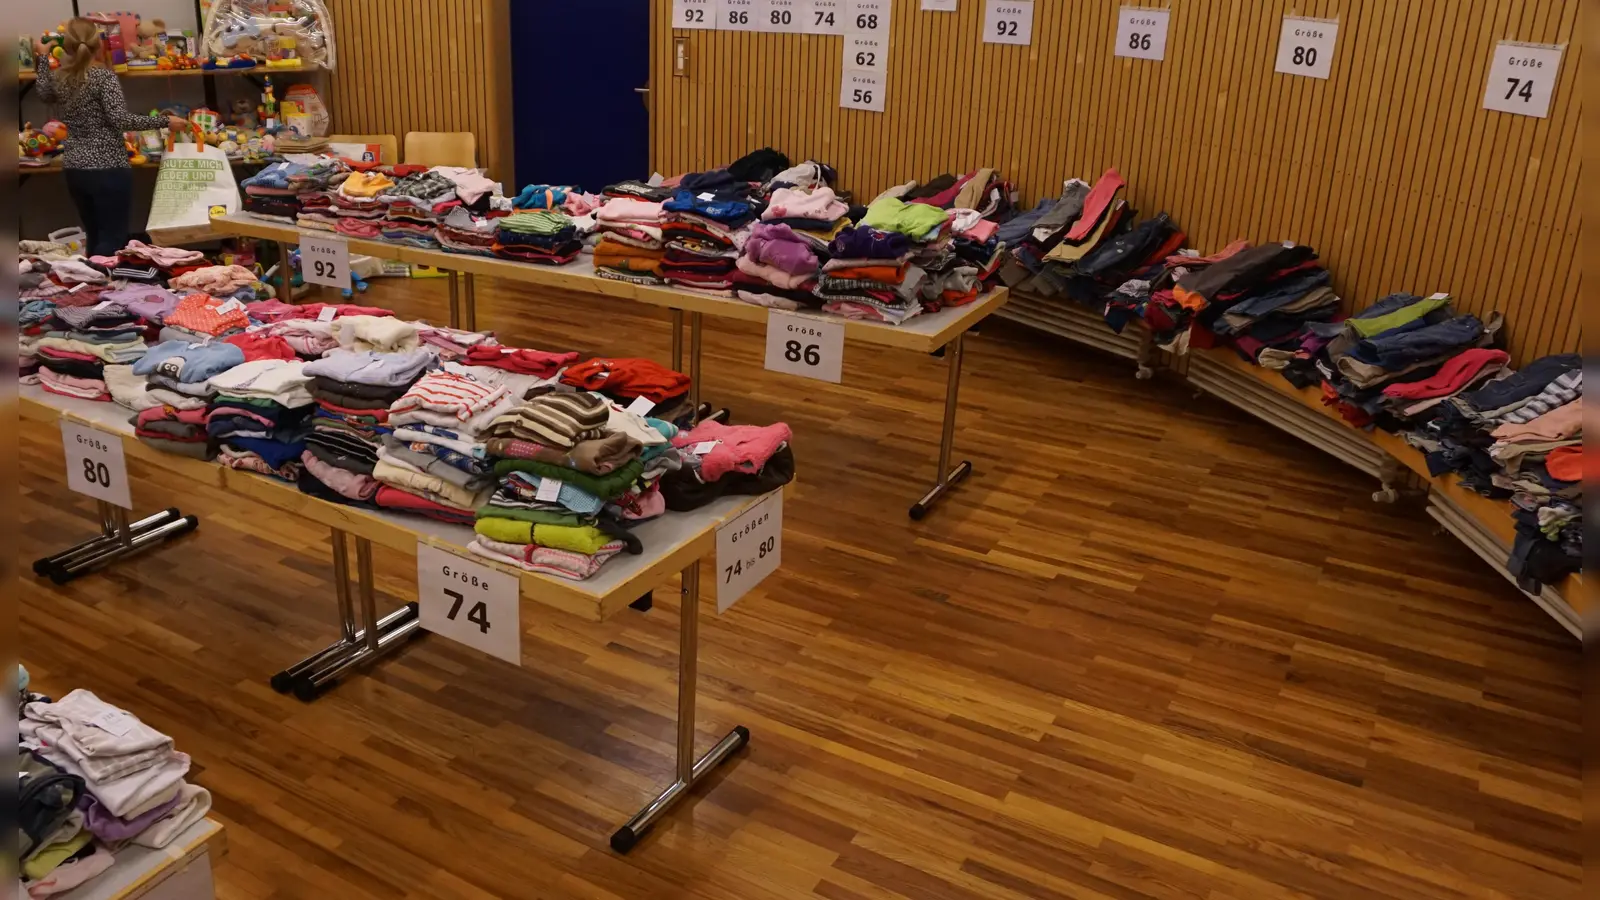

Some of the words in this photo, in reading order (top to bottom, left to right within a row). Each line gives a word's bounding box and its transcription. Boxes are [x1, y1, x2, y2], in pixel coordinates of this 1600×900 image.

[685, 9, 704, 22] 92
[728, 11, 749, 24] 86
[770, 10, 791, 24] 80
[814, 12, 835, 26] 74
[856, 14, 878, 29] 68
[1130, 17, 1156, 26] Größe
[997, 21, 1018, 36] 92
[1295, 29, 1323, 38] Größe
[1129, 33, 1151, 50] 86
[855, 52, 875, 66] 62
[1292, 46, 1317, 67] 80
[1508, 57, 1543, 68] Größe
[852, 89, 872, 104] 56
[1504, 78, 1534, 102] 74
[161, 160, 195, 169] NUTZE
[197, 160, 223, 169] MICH
[158, 171, 189, 180] IEDER
[192, 172, 214, 180] UND
[311, 245, 336, 255] Größe
[314, 260, 336, 279] 92
[787, 324, 822, 337] Größe
[784, 340, 820, 366] 86
[76, 434, 108, 452] Größe
[82, 457, 110, 488] 80
[731, 512, 769, 543] Größen
[725, 559, 742, 584] 74
[746, 557, 755, 570] bis
[759, 535, 775, 558] 80
[442, 565, 489, 591] Größe
[443, 587, 491, 634] 74
